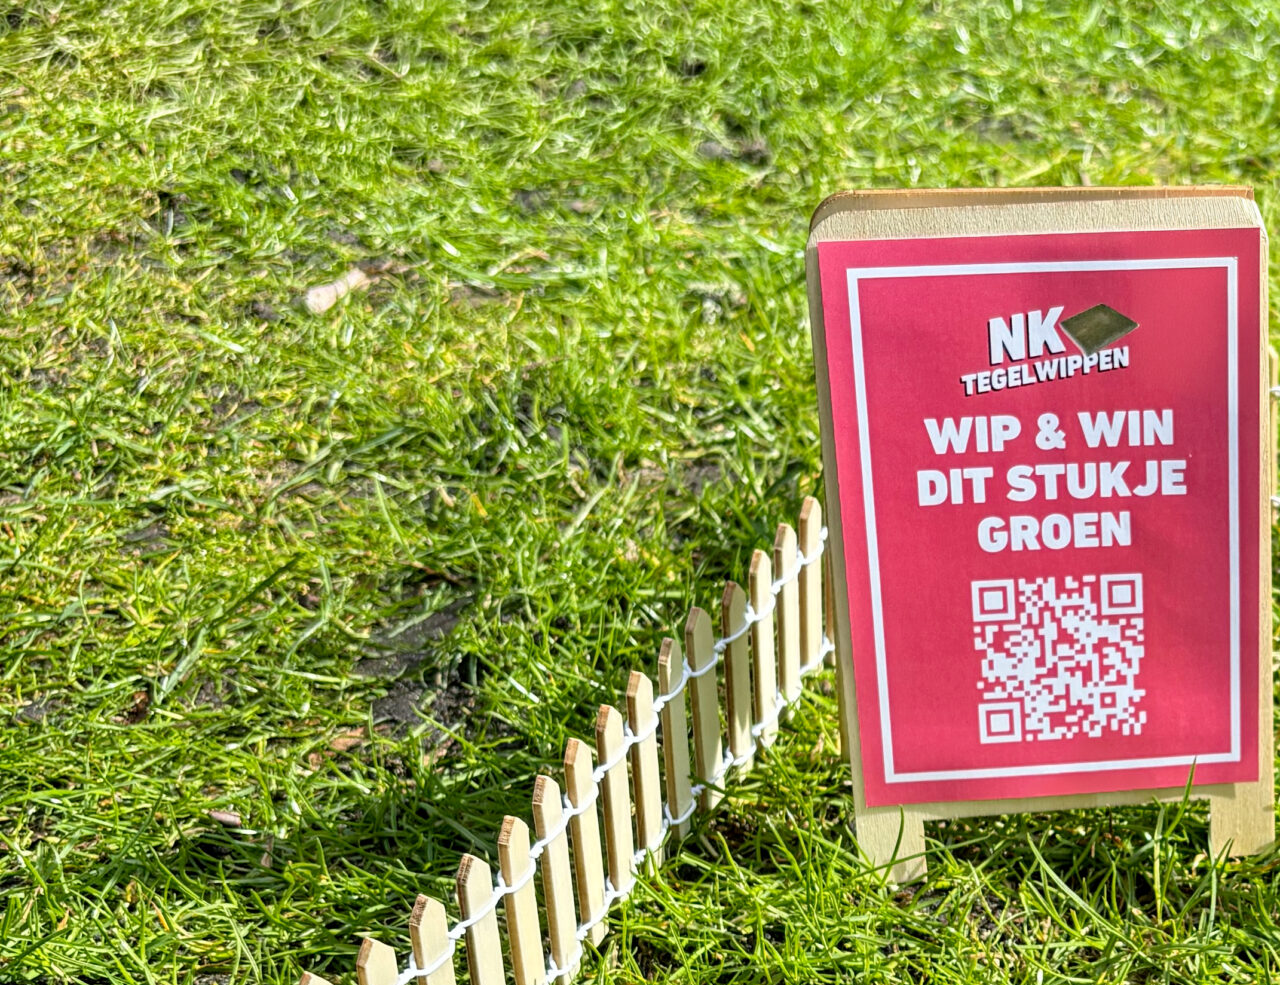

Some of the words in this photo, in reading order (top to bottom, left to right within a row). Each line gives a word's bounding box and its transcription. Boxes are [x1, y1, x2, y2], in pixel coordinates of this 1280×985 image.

[988, 306, 1064, 364] NK
[961, 346, 1130, 397] TEGELWIPPEN
[924, 415, 1021, 455] WIP
[1035, 413, 1066, 450] &
[1077, 409, 1174, 447] WIN
[917, 468, 993, 506] DIT
[1006, 460, 1187, 502] STUKJE
[977, 511, 1132, 553] GROEN
